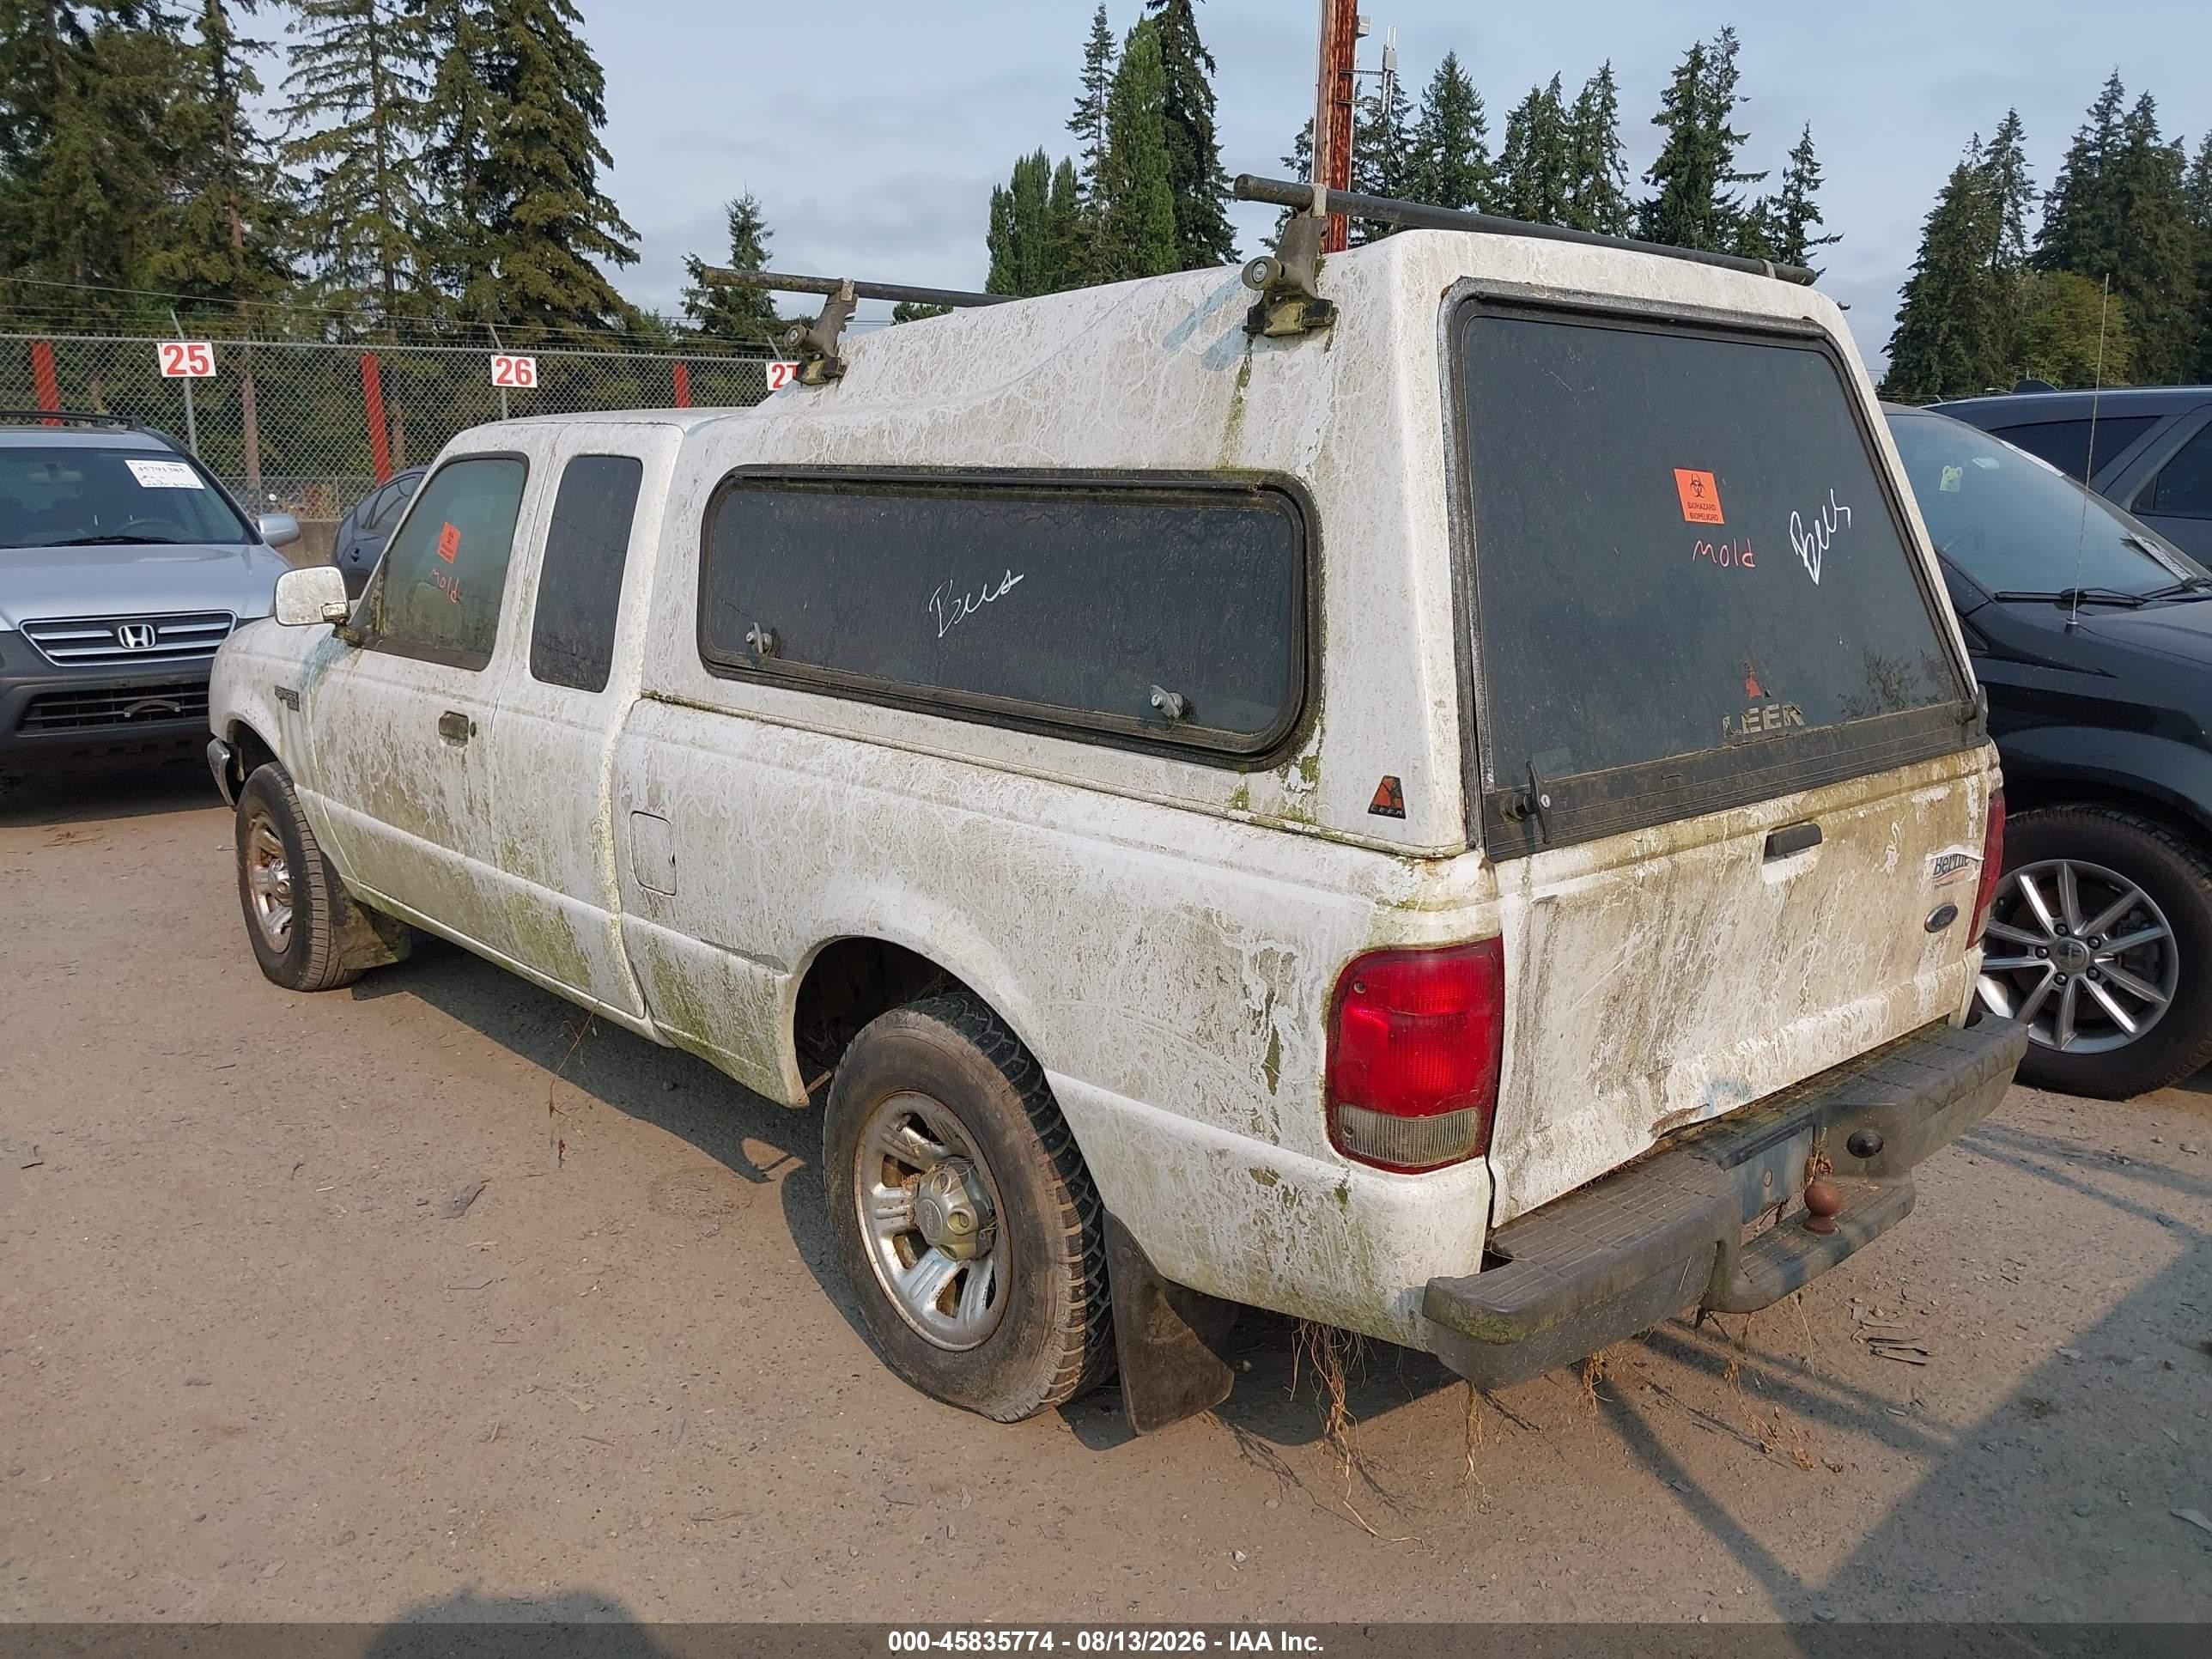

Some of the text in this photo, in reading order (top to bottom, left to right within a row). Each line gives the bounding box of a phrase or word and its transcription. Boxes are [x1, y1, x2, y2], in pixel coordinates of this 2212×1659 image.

[163, 344, 210, 375] 25
[495, 357, 532, 386] 26
[1686, 501, 1717, 512] BIOHAZARD
